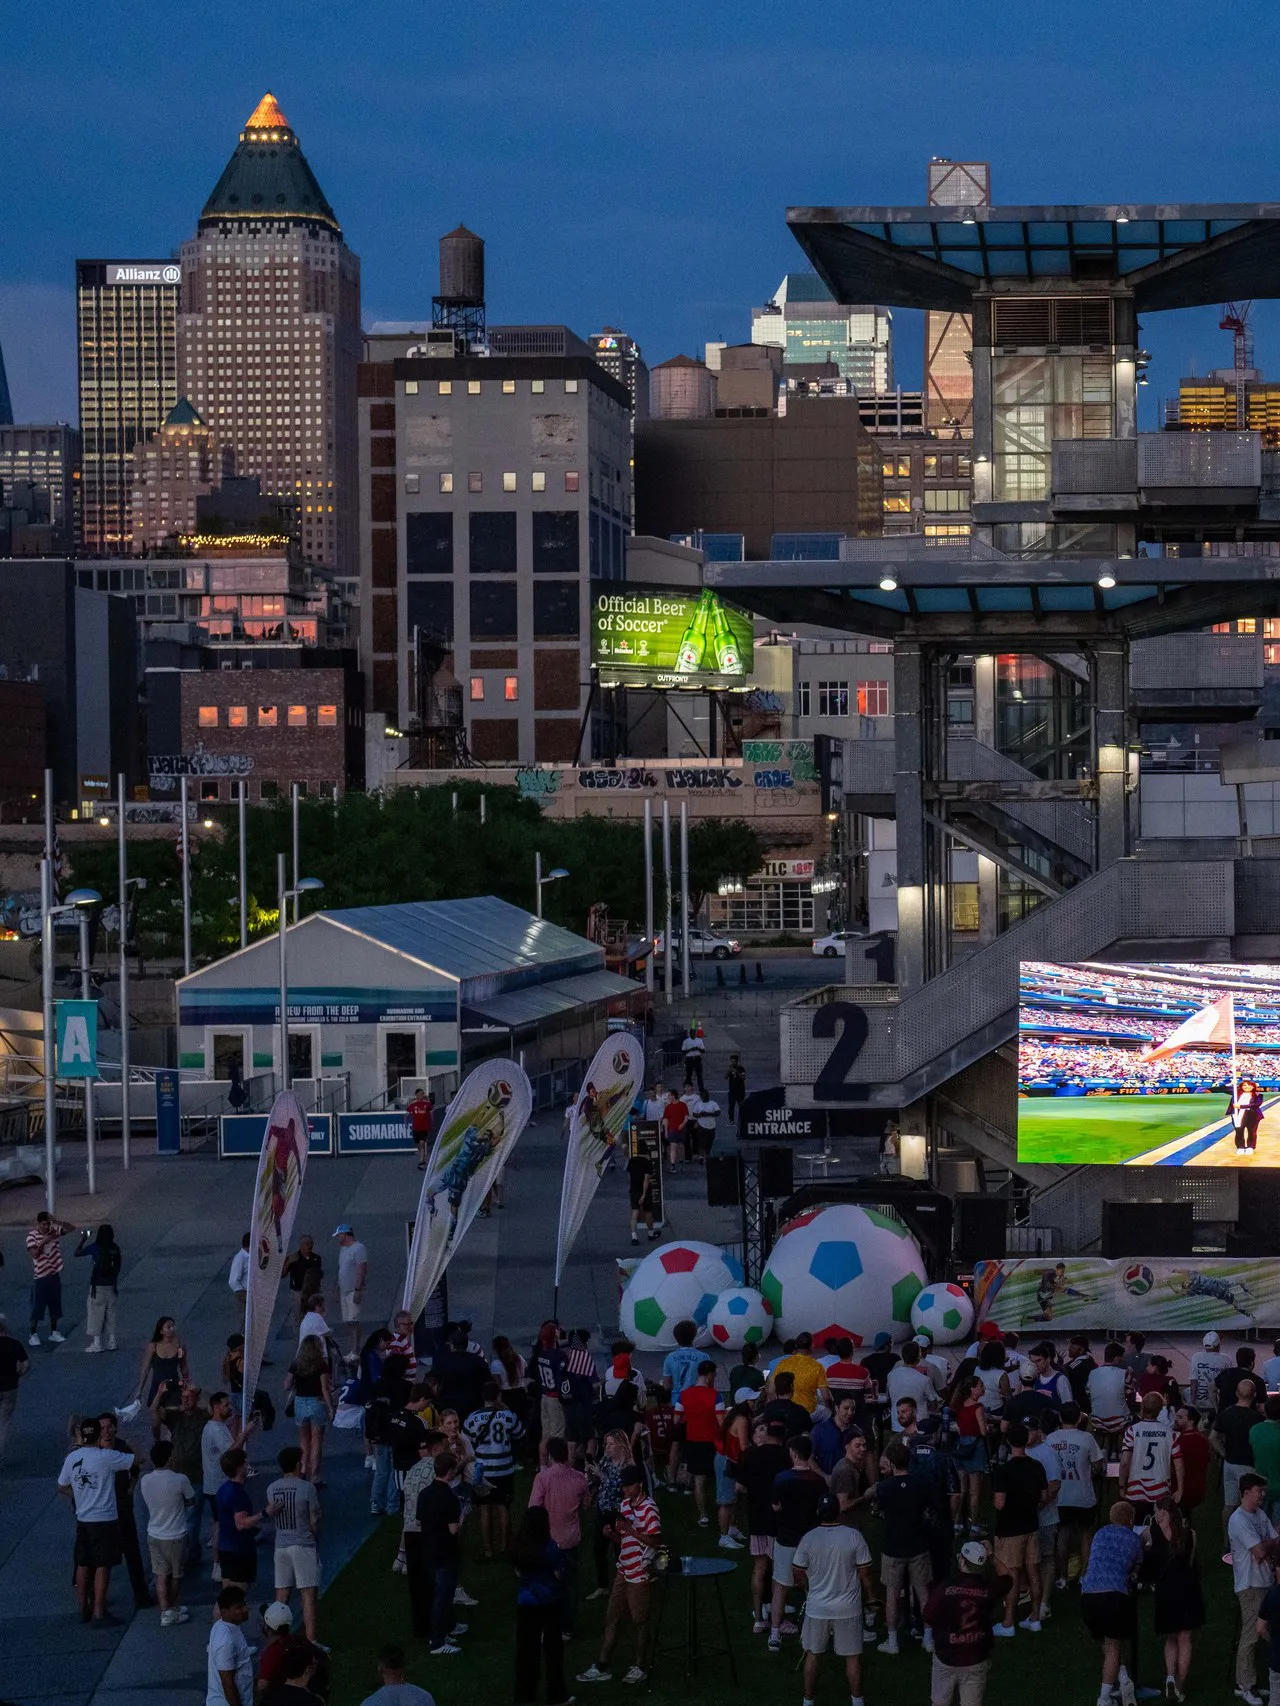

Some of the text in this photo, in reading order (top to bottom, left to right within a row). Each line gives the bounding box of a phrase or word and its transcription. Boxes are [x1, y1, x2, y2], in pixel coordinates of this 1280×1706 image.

[116, 268, 160, 280] Allianz
[599, 595, 686, 616] Official Beer
[598, 615, 614, 631] of
[275, 1007, 281, 1016] A
[302, 1006, 324, 1016] FROM
[326, 1006, 340, 1016] THE
[341, 1005, 360, 1016] DEEP
[61, 1016, 92, 1063] A
[812, 1001, 869, 1101] 2
[765, 1109, 793, 1122] SHIP
[747, 1121, 812, 1135] ENTRANCE
[681, 1361, 691, 1387] 7
[1142, 1430, 1167, 1438] ROBINSON
[1143, 1442, 1158, 1471] 5
